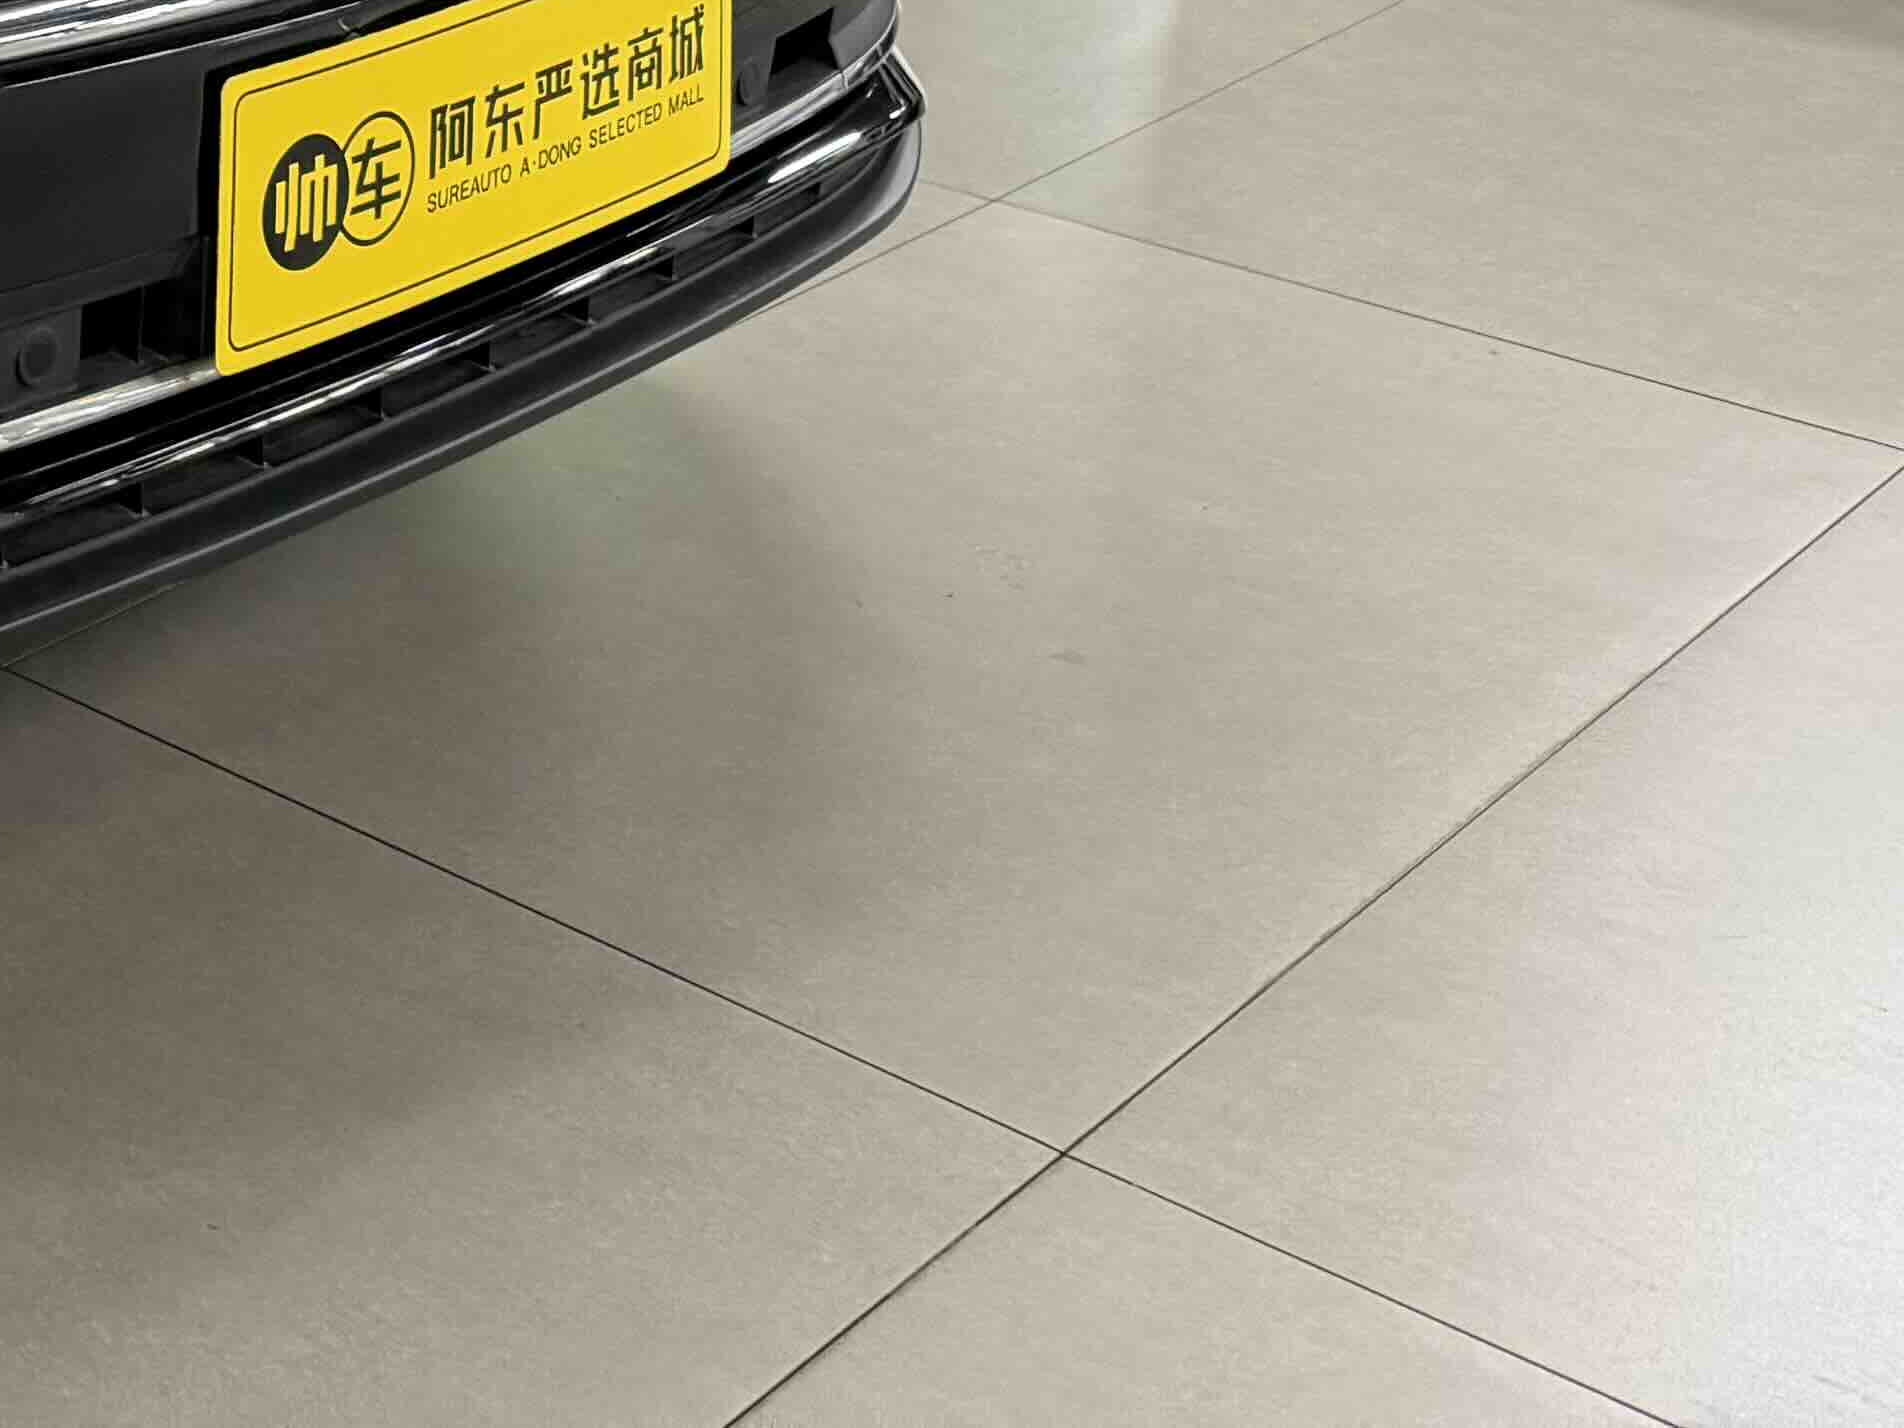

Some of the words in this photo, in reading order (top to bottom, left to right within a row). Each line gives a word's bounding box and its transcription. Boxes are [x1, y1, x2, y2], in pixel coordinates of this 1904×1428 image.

[426, 164, 513, 214] SUREAUTO
[588, 102, 663, 149] SELECTED
[667, 83, 705, 115] MALL
[428, 2, 705, 180] 阿东严选商城
